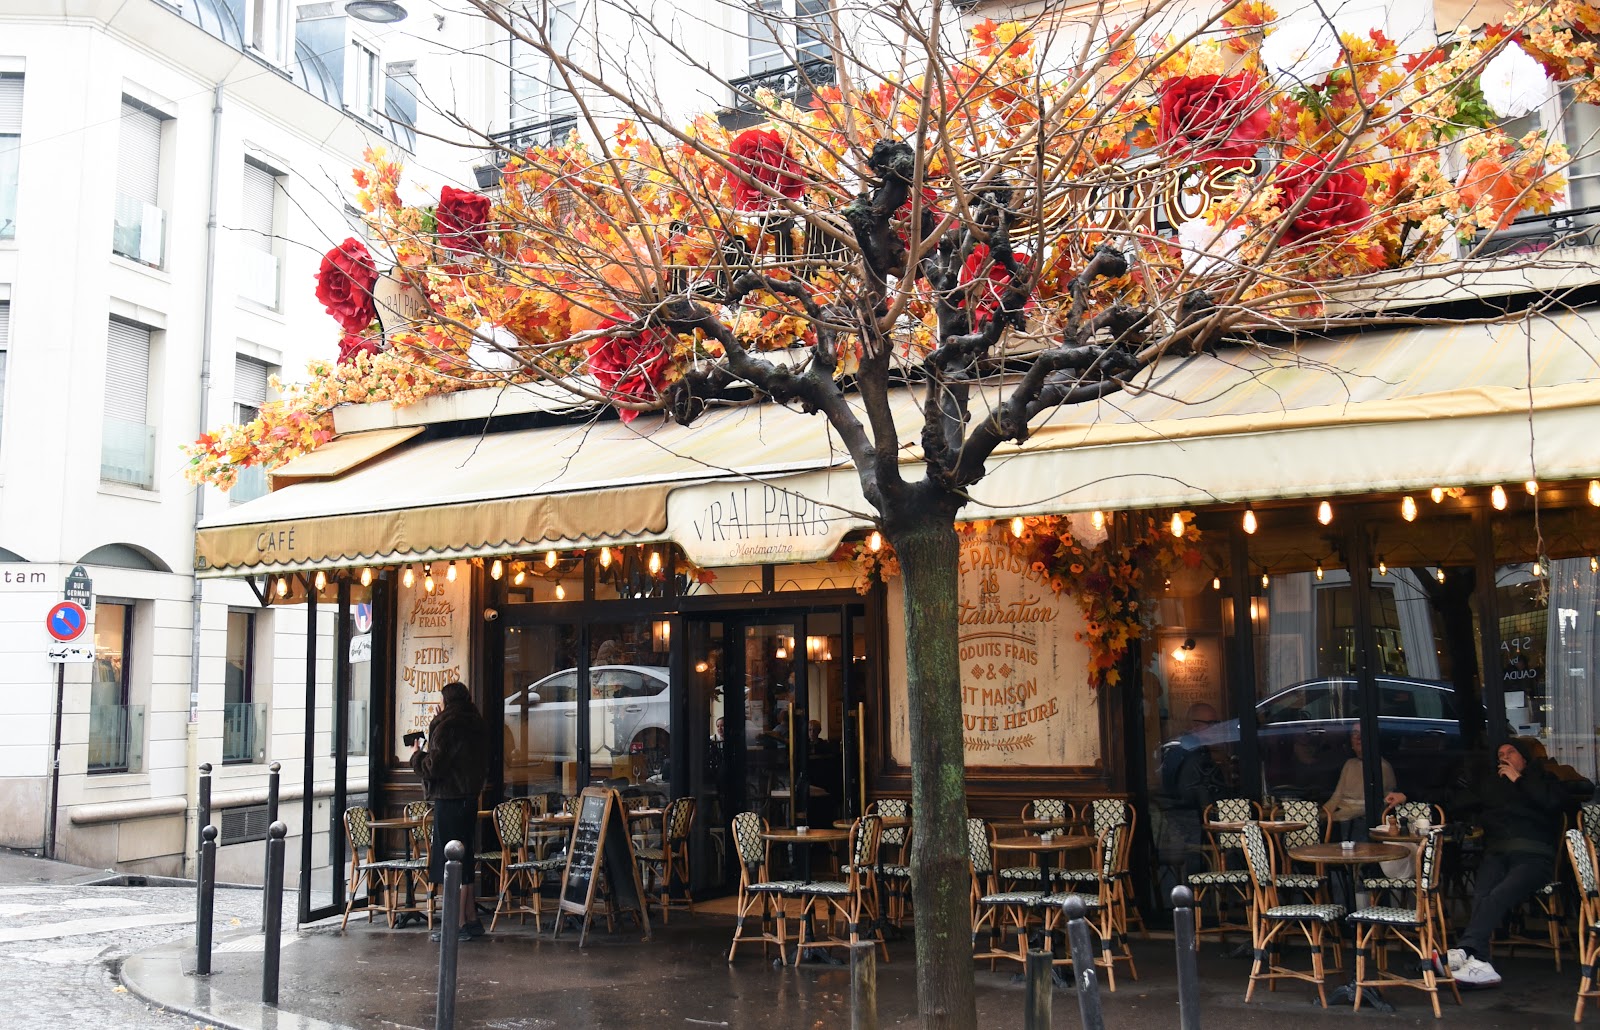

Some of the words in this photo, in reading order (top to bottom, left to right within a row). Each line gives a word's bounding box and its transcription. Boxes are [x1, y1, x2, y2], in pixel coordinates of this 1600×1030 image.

[405, 294, 421, 317] PAR
[693, 487, 750, 542] VRAI
[764, 485, 829, 539] PARIS
[257, 527, 295, 552] CAFÉ
[729, 543, 793, 558] Montmartre
[66, 589, 90, 597] GERMAIN
[73, 582, 85, 590] RUE
[980, 572, 999, 594] 18
[411, 599, 456, 625] fruits
[419, 615, 447, 628] FRAIS
[958, 594, 1060, 626] tauration
[415, 647, 449, 665] PETITS
[960, 642, 1002, 662] ODUITS
[1005, 644, 1038, 666] FRAIS
[403, 665, 461, 695] DÉJEUNERS
[985, 663, 997, 681] &
[982, 677, 1037, 707] MAISON
[963, 713, 999, 732] UTE
[1004, 697, 1059, 730] HEURE
